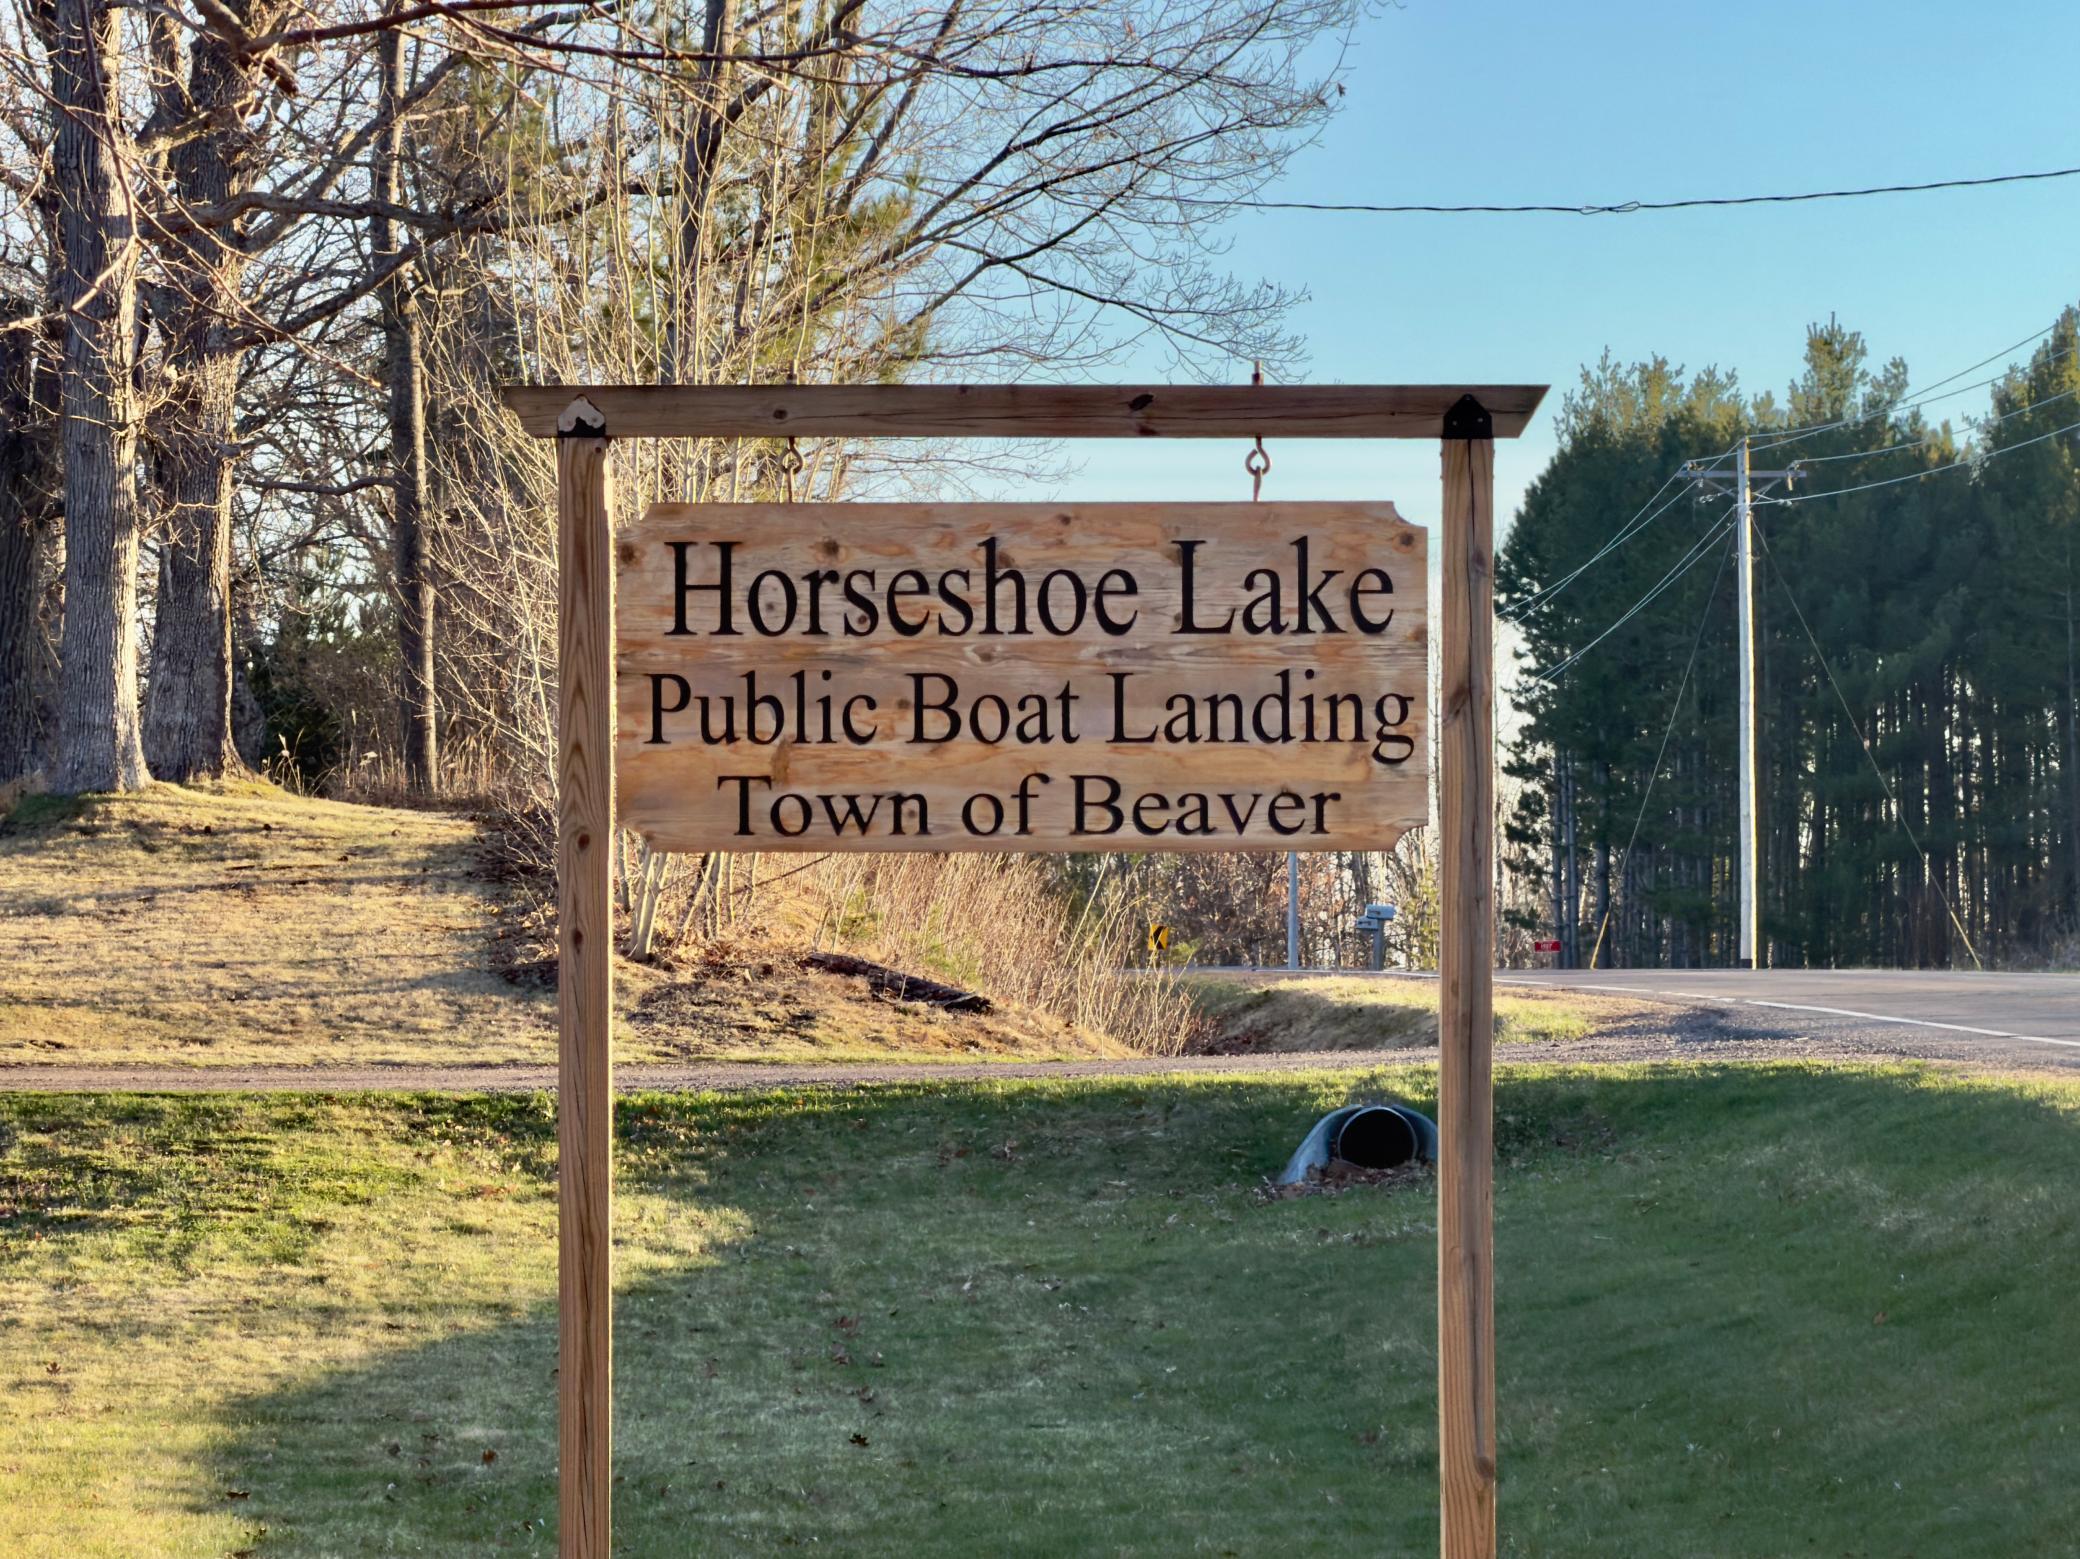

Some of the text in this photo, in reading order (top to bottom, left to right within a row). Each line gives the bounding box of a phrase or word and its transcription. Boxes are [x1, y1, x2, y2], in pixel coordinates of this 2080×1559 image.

[663, 536, 1394, 637] Horseshoe Lake
[642, 668, 1414, 765] Public Boat Landing
[718, 772, 1341, 837] Town of Beaver
